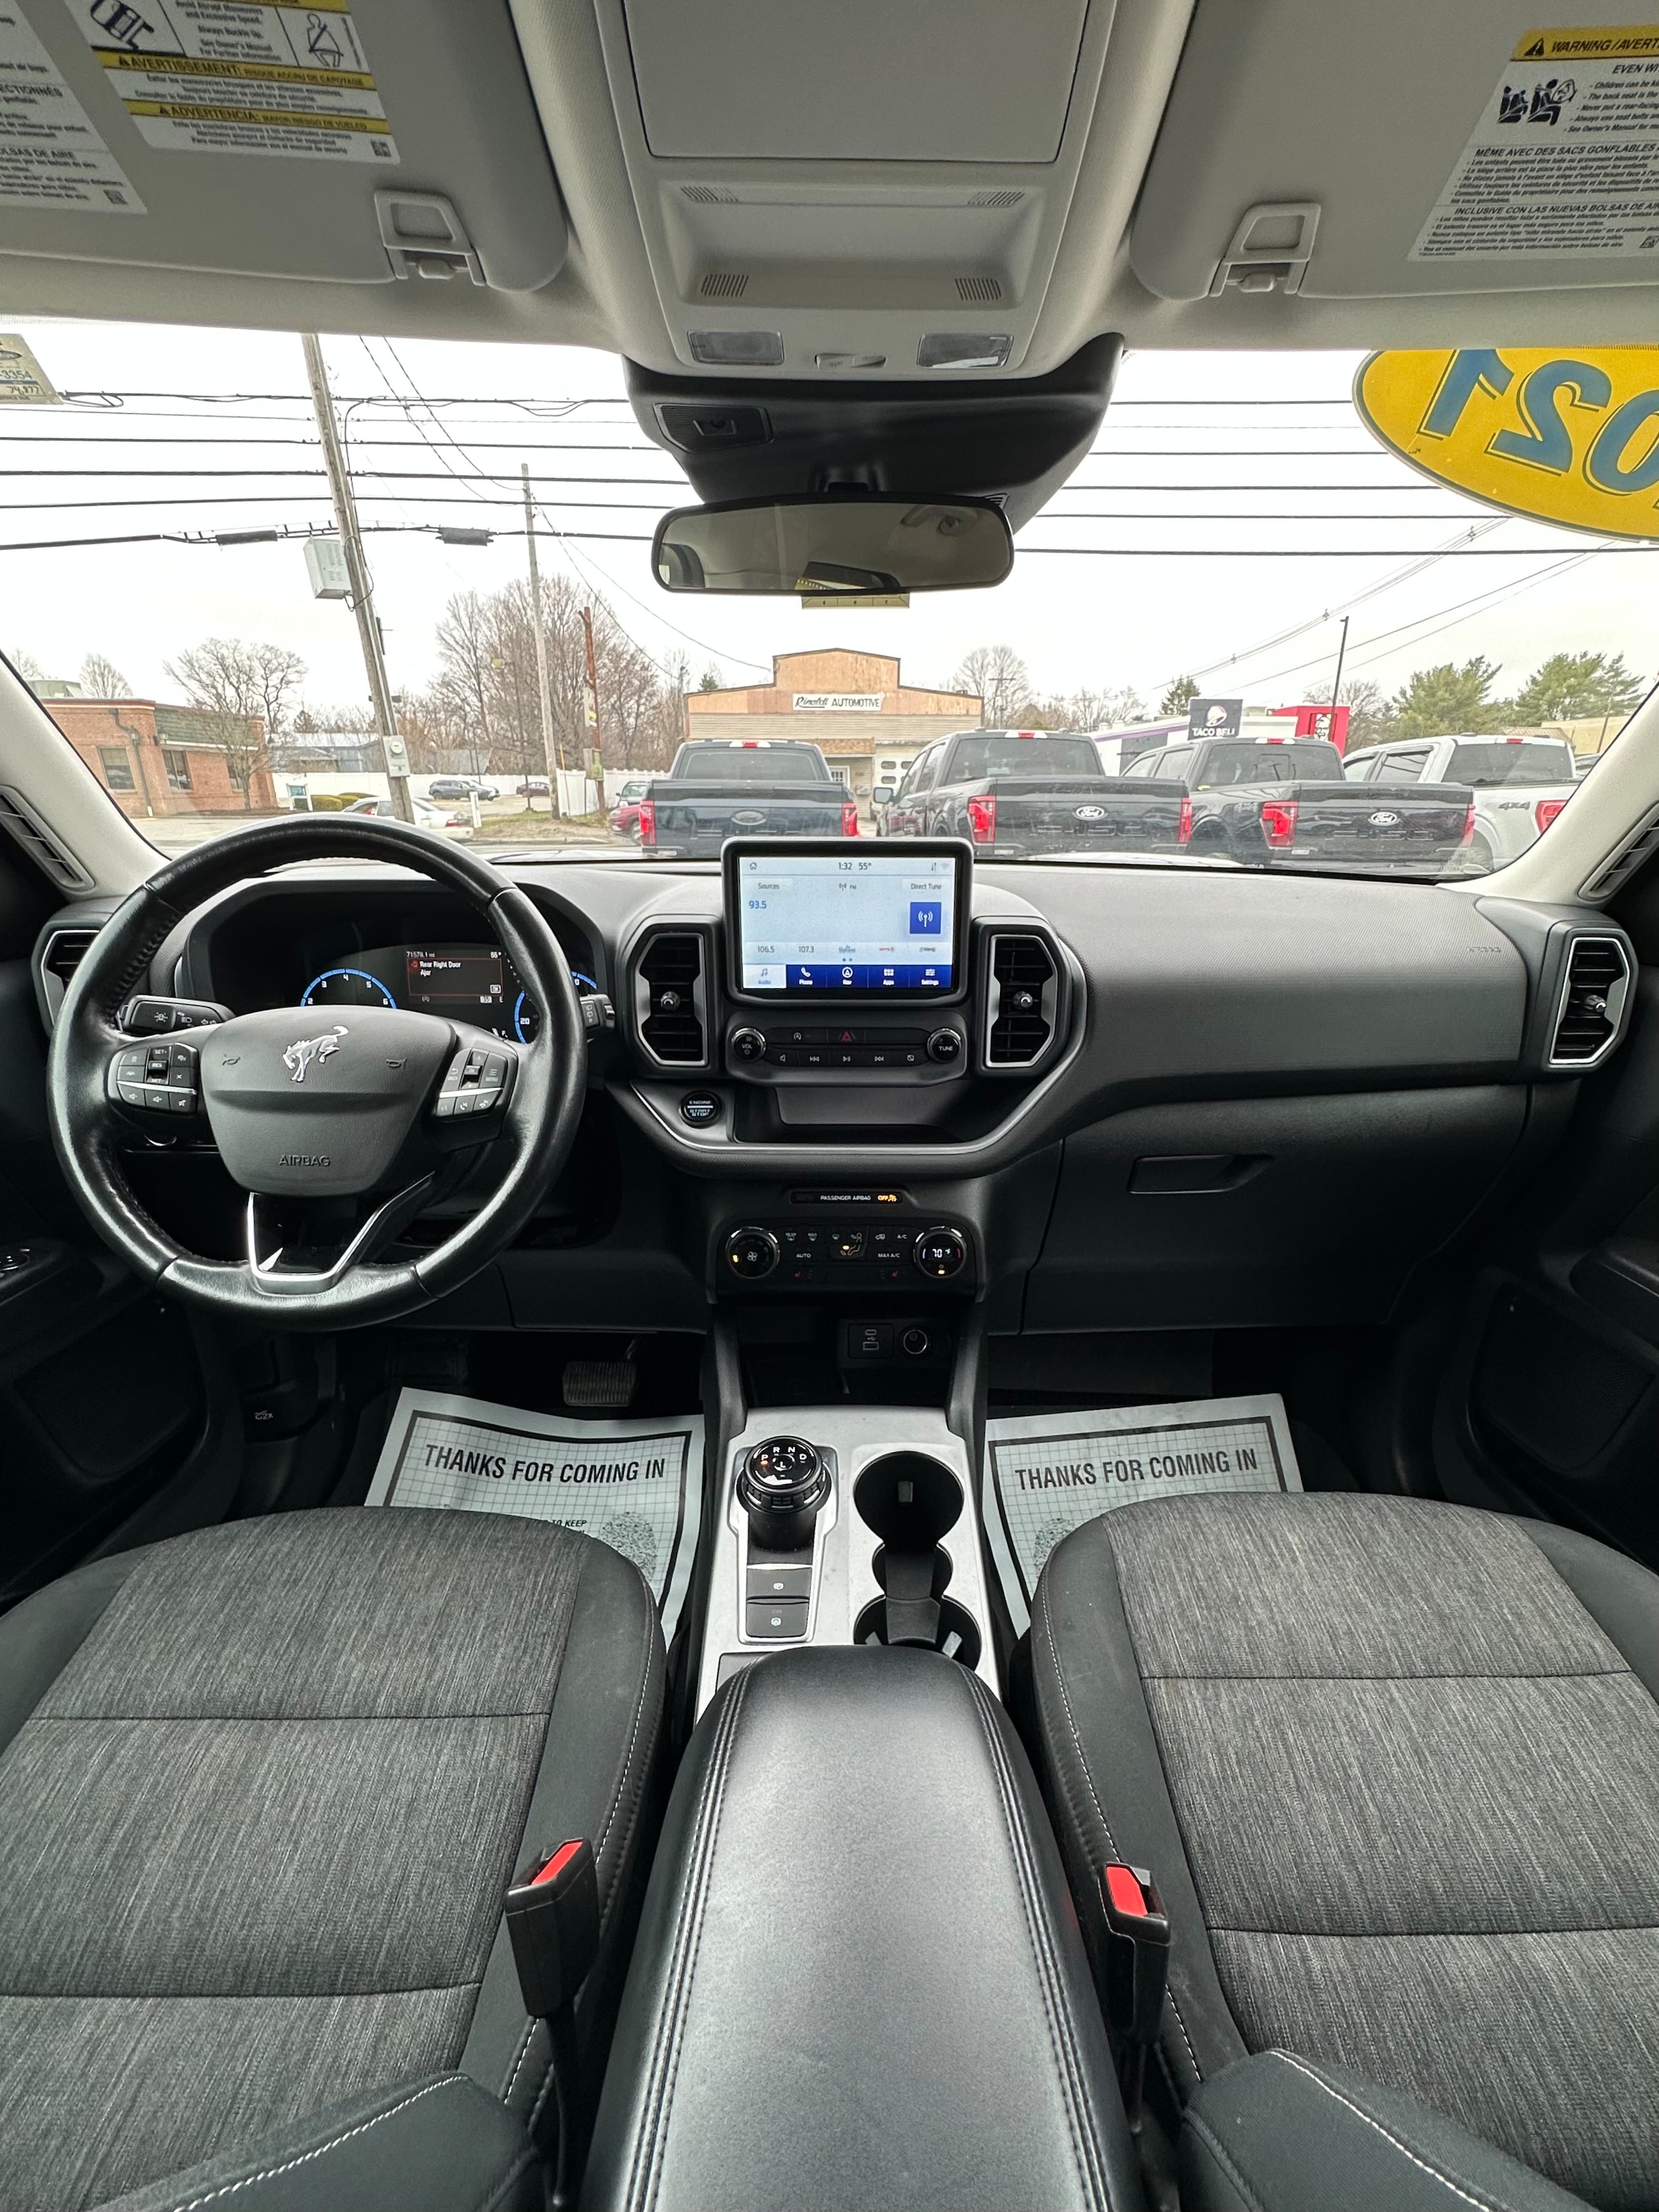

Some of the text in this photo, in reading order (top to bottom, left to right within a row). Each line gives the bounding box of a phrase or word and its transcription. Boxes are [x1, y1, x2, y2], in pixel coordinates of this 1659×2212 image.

[1551, 40, 1611, 52] WARNING
[1613, 64, 1644, 74] EVEN
[1475, 143, 1656, 157] MÊME AVEC DES SACS GONFLABLES
[1589, 204, 1630, 212] BOLSAS
[795, 696, 880, 708] Rinaldi AUTOMOTIVE
[1192, 727, 1214, 736] TACO
[749, 901, 768, 909] 93.5
[279, 1155, 331, 1167] AIRBAG
[932, 1248, 942, 1258] 70
[425, 1444, 666, 1484] THANKS FOR COMING IN
[1015, 1447, 1258, 1491] THANKS FOR COMING IN
